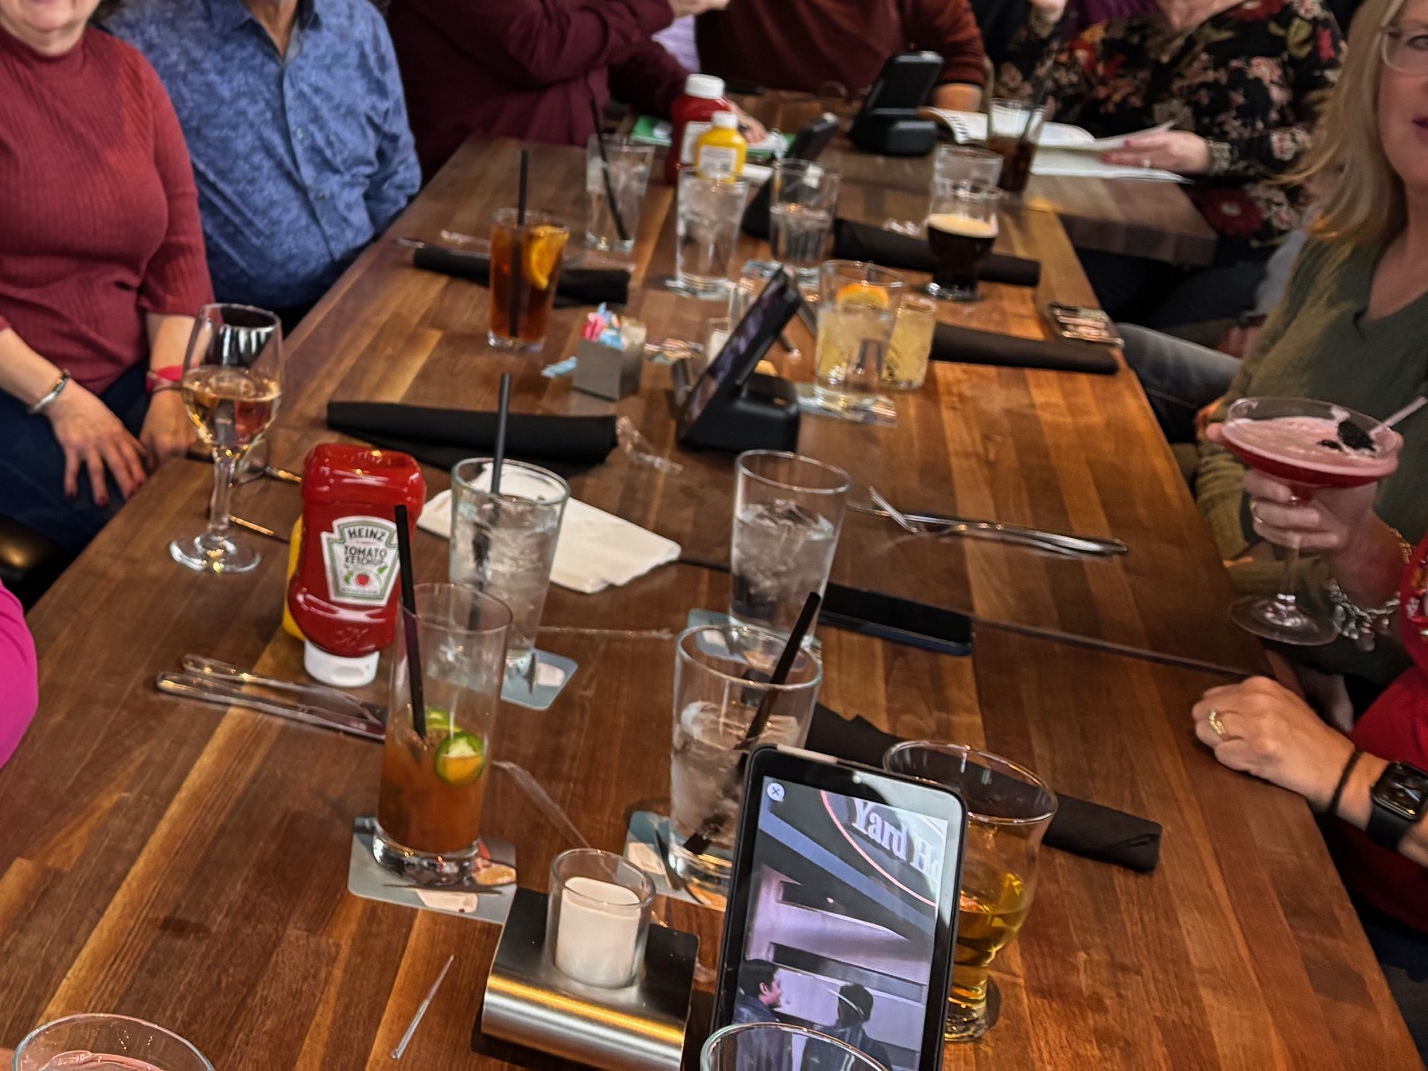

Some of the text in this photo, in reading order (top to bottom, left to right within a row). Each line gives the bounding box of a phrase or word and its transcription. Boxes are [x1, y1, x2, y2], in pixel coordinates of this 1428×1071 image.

[348, 527, 386, 542] HEINZ
[344, 545, 387, 558] TOMATO
[345, 555, 385, 566] KETCHUP
[852, 796, 908, 861] Yard
